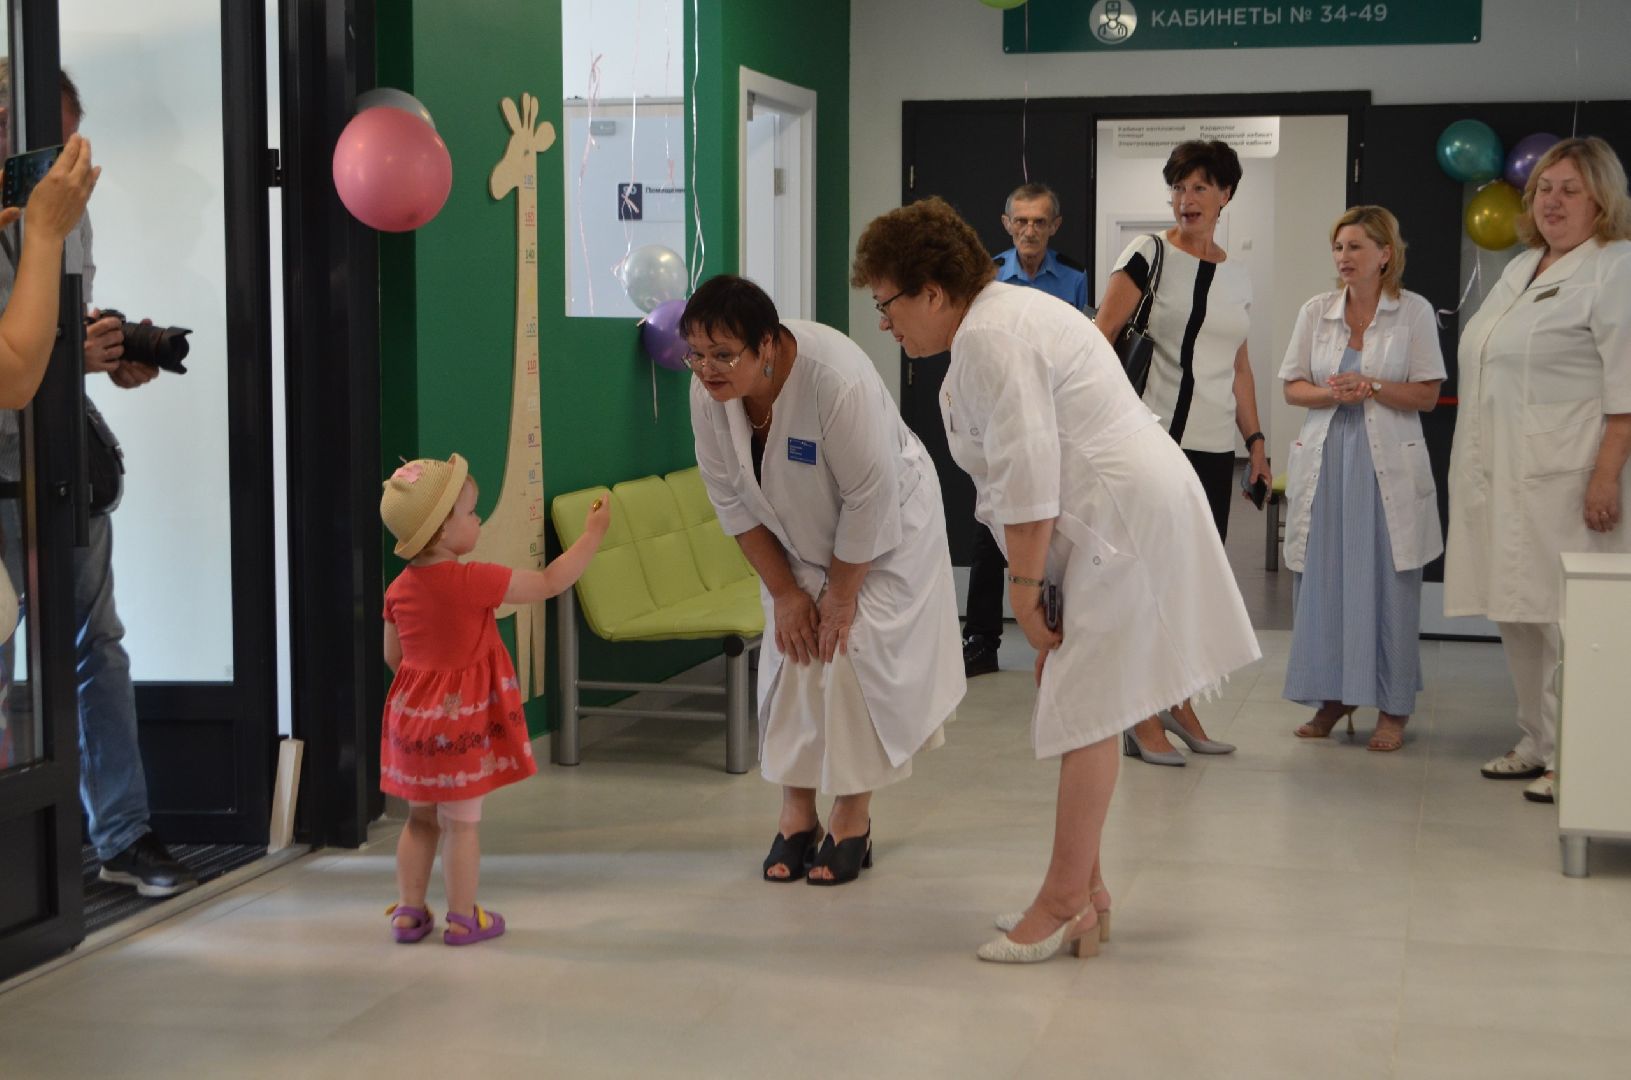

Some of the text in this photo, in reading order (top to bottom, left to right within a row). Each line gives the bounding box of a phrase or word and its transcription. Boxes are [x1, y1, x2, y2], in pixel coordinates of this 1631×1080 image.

[1151, 4, 1388, 28] КАБИНЕТЫ № 34-49
